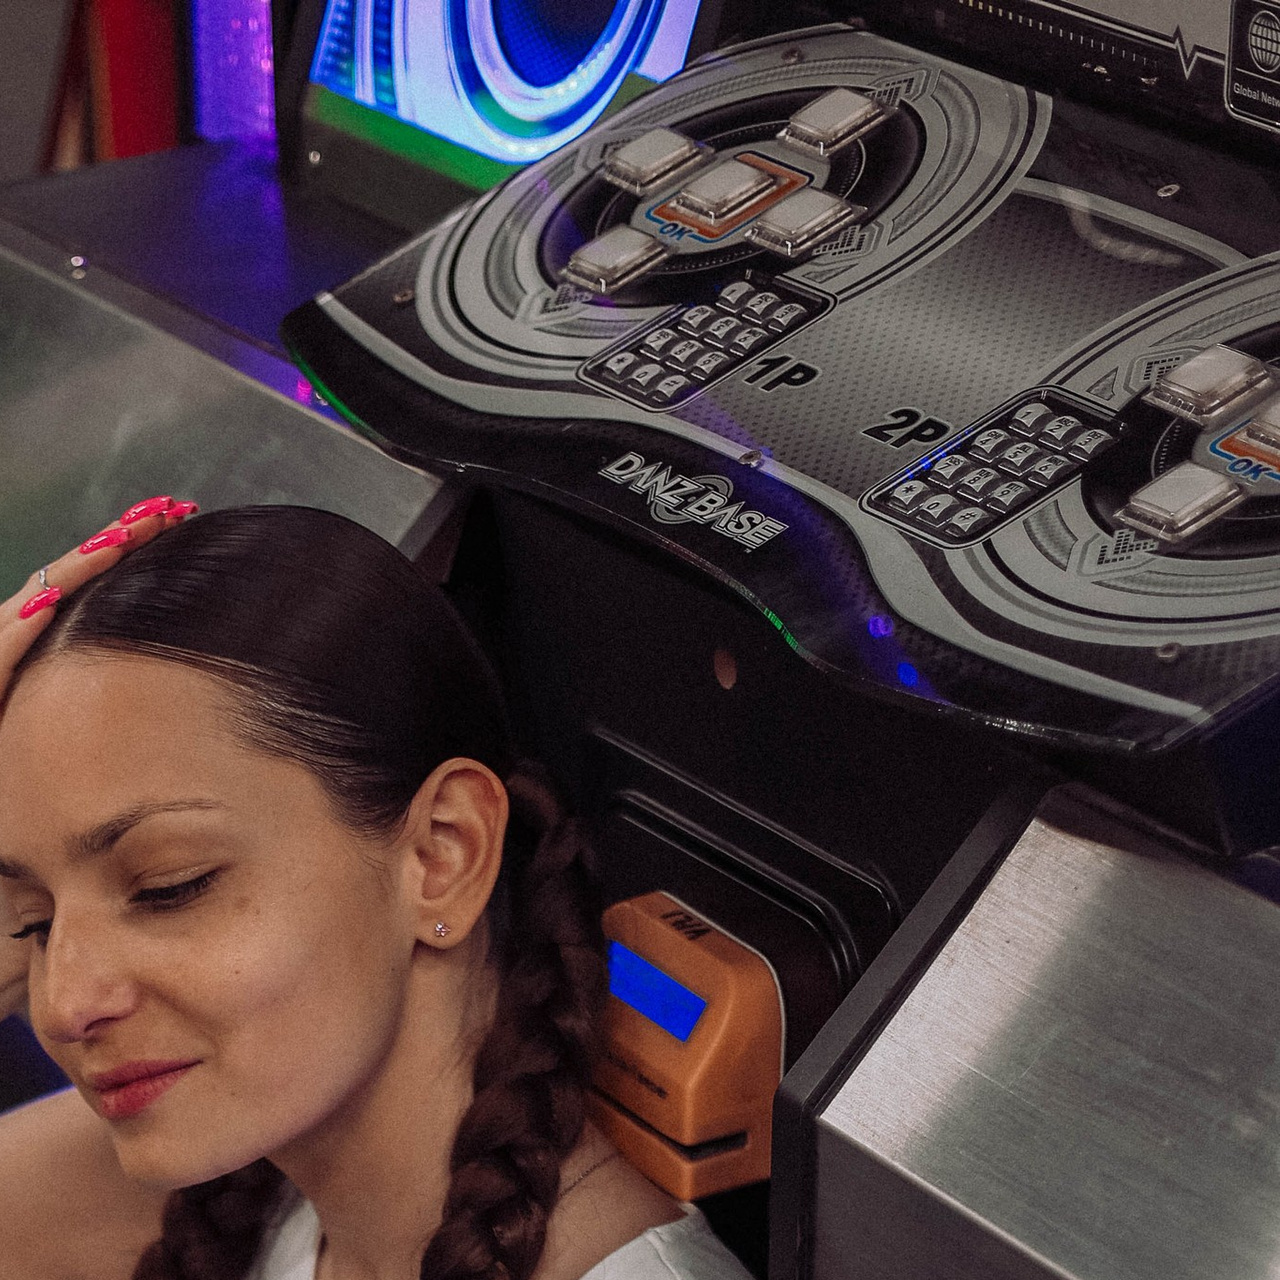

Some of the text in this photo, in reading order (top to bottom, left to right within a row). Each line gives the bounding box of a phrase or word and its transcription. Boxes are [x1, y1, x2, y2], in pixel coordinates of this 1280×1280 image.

[1233, 82, 1260, 100] Global
[659, 222, 693, 240] OK
[636, 371, 648, 379] 0
[745, 355, 819, 391] 1P
[1021, 411, 1032, 419] 1
[862, 408, 950, 448] 2P
[1048, 424, 1063, 433] 2
[980, 438, 992, 446] 4
[1080, 438, 1092, 446] 3
[1008, 449, 1022, 458] 5
[1039, 463, 1052, 472] 6
[1228, 458, 1272, 481] OK
[968, 476, 981, 484] 8
[598, 451, 790, 549] DANZ BASE
[927, 502, 940, 510] 0
